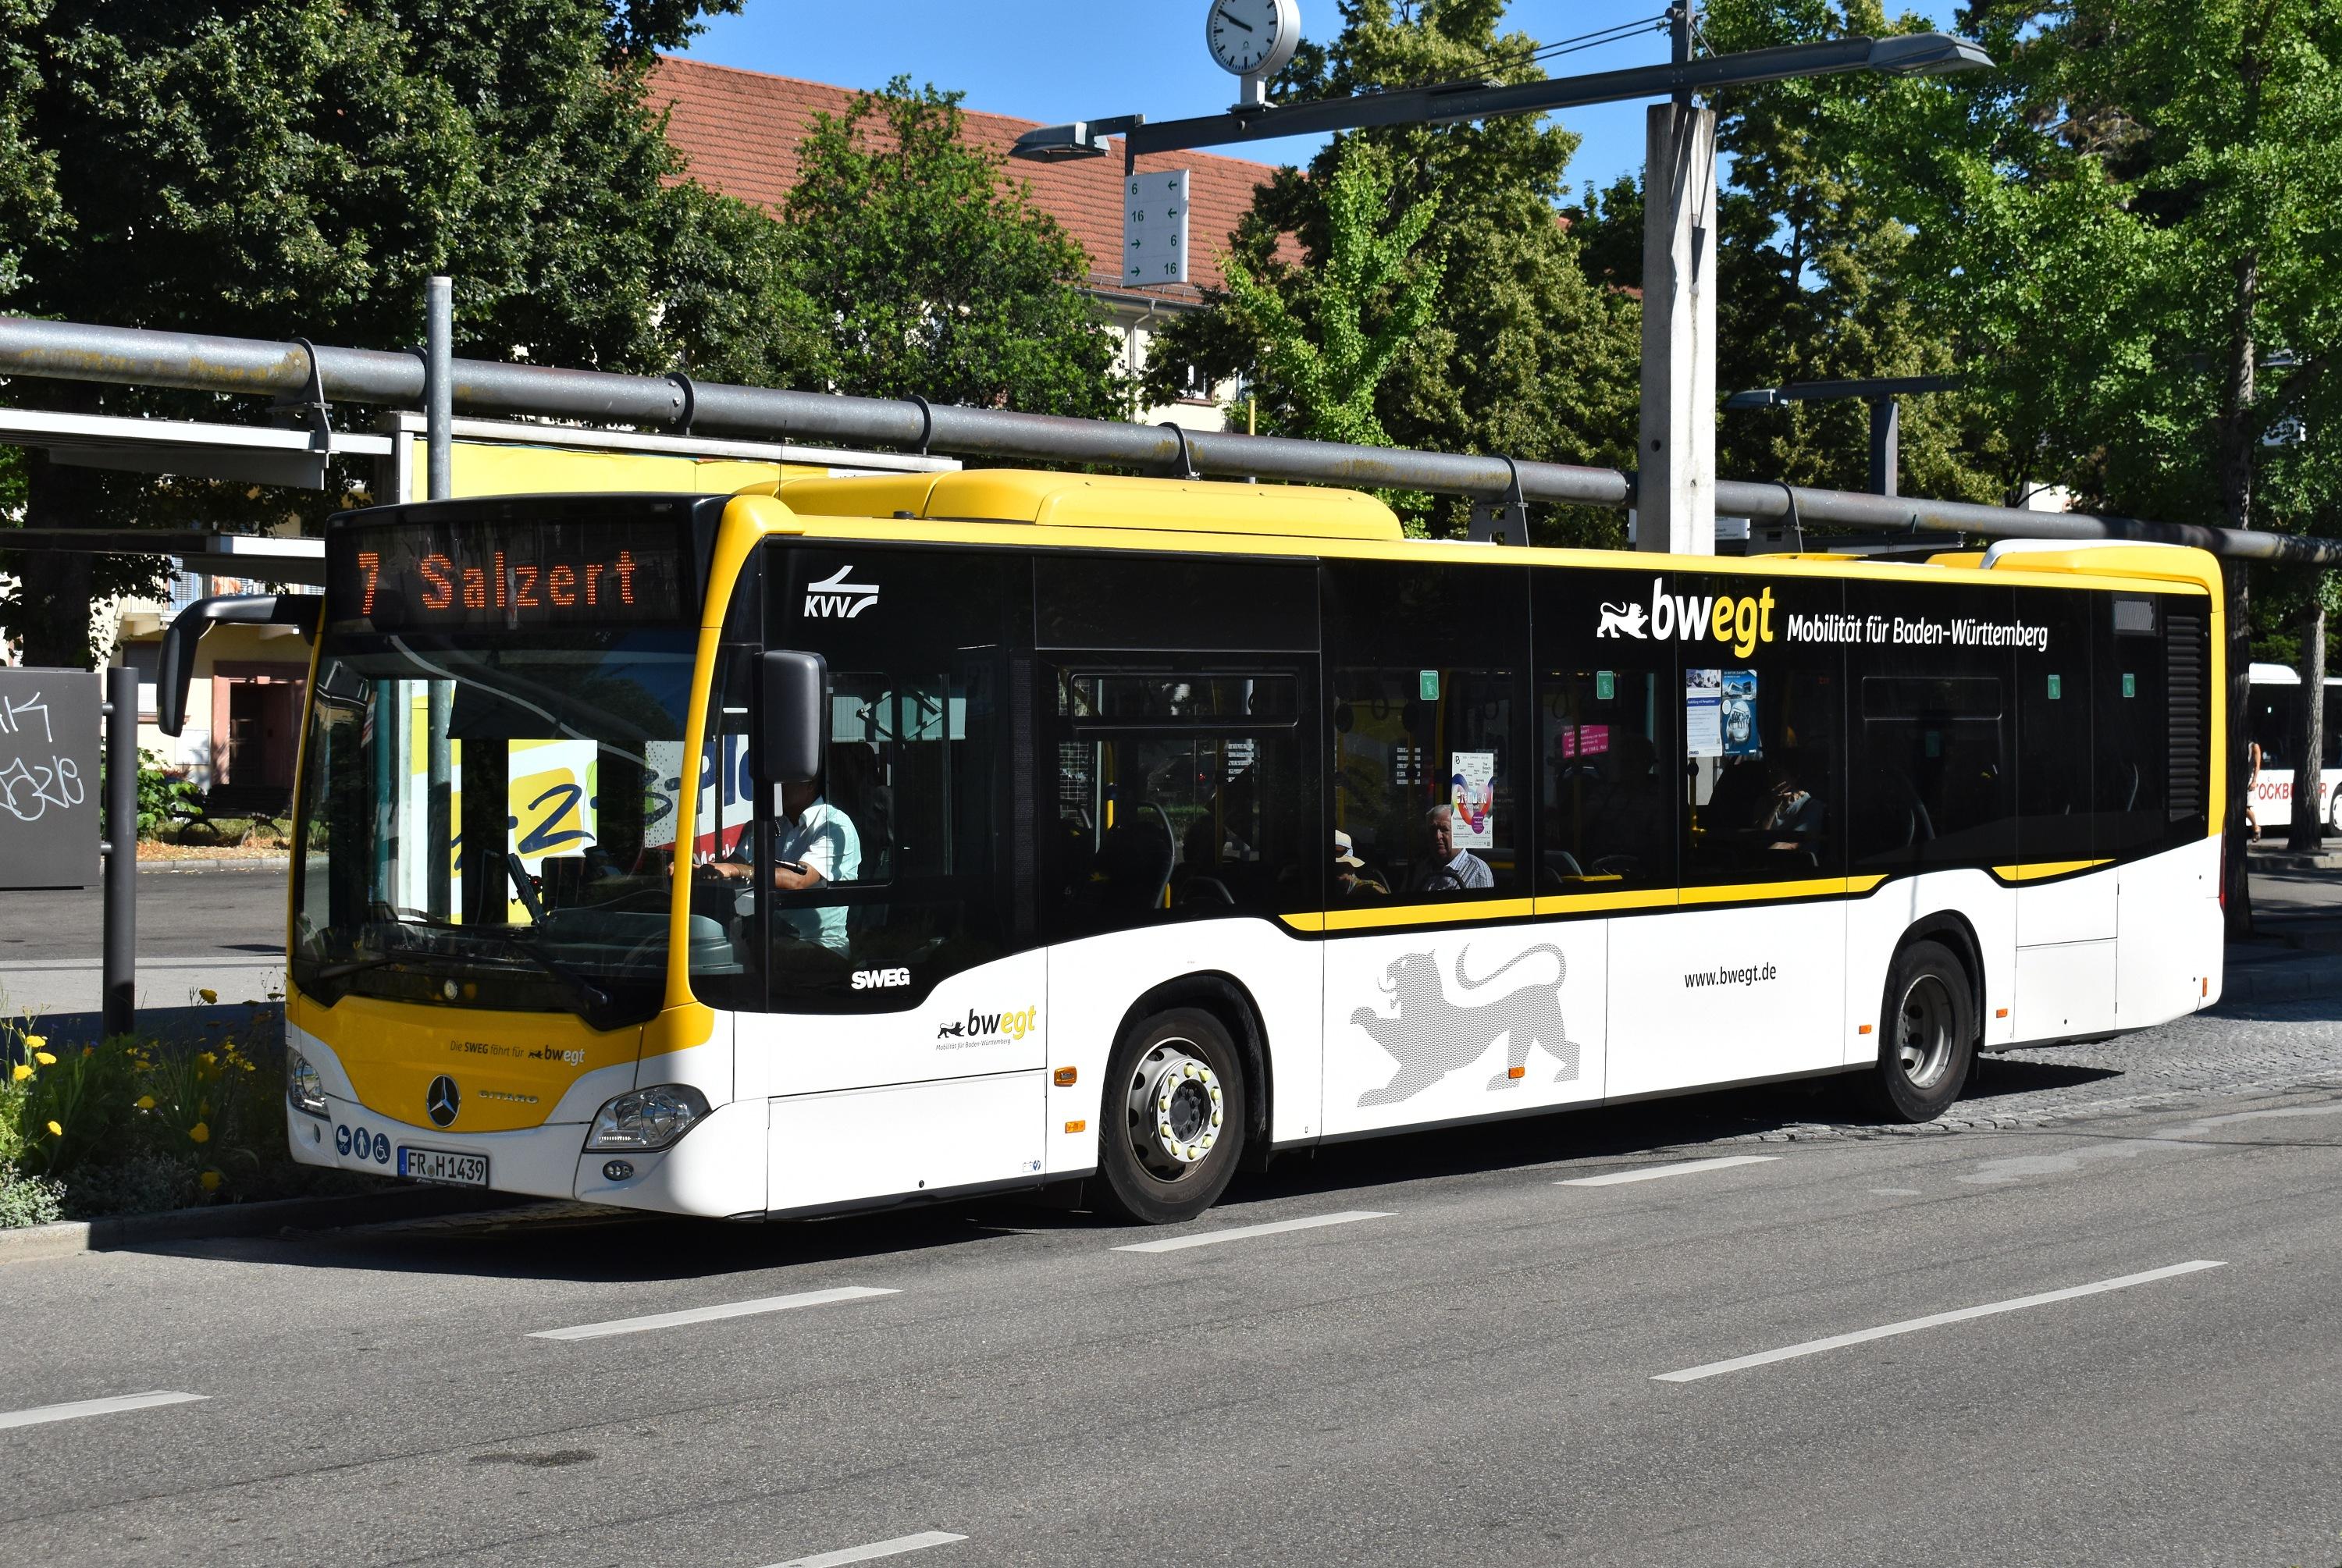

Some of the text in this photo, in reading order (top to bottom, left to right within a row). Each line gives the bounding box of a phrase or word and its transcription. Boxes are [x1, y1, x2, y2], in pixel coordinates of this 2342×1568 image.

[1131, 183, 1138, 195] 6
[1131, 210, 1144, 222] 16
[1170, 234, 1177, 247] 6
[1164, 262, 1177, 275] 16
[358, 549, 636, 614] 7 Salzert
[1651, 577, 1775, 659] bwegt
[1786, 613, 2049, 653] Mobilität für Baden-Württemberg
[851, 967, 910, 990] SWEG
[1684, 962, 1777, 987] www.bwegt.de
[967, 1005, 1037, 1040] bwegt
[450, 1040, 586, 1066] Die SWEG fährt für bwegt
